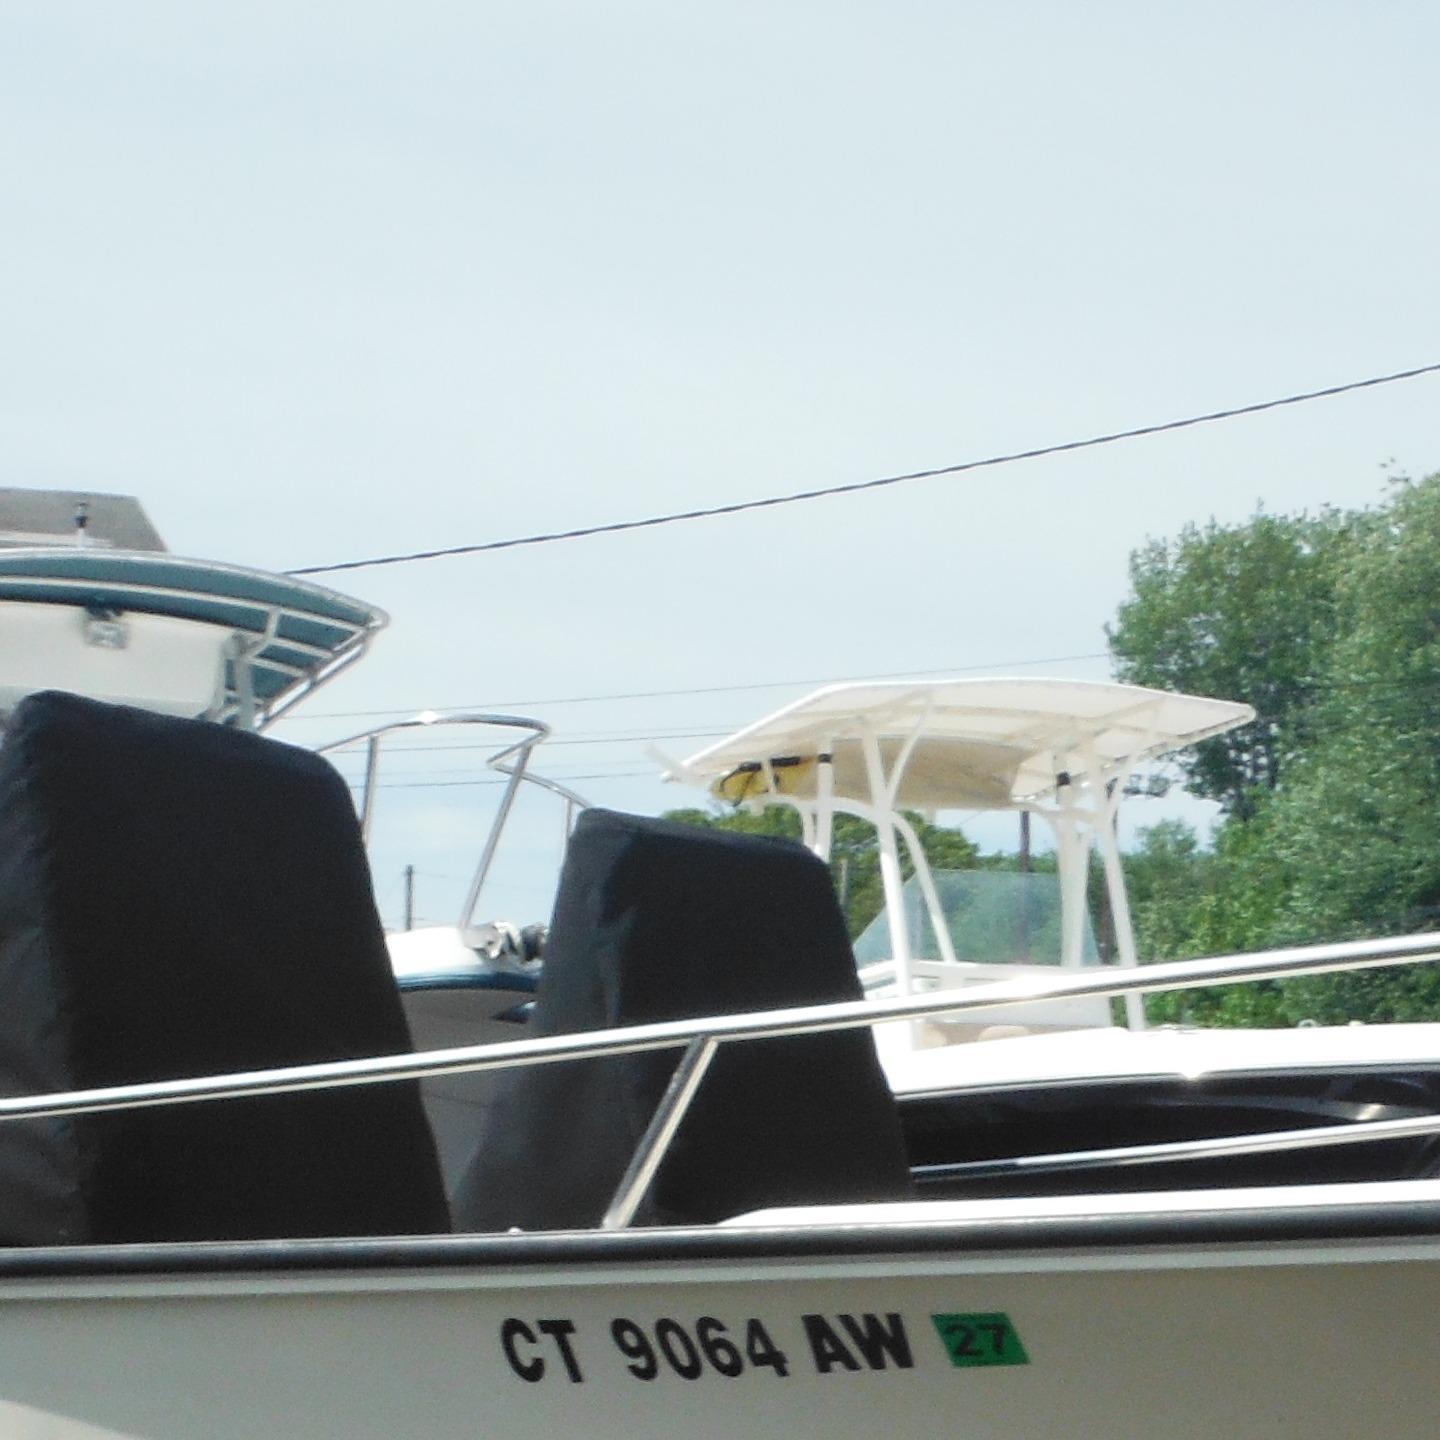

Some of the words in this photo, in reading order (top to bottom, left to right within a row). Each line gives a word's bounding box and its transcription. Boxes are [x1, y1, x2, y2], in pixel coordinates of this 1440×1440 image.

[501, 1317, 584, 1383] CT
[610, 1316, 790, 1381] 9064
[801, 1312, 915, 1374] AW
[945, 1322, 1010, 1358] 27
